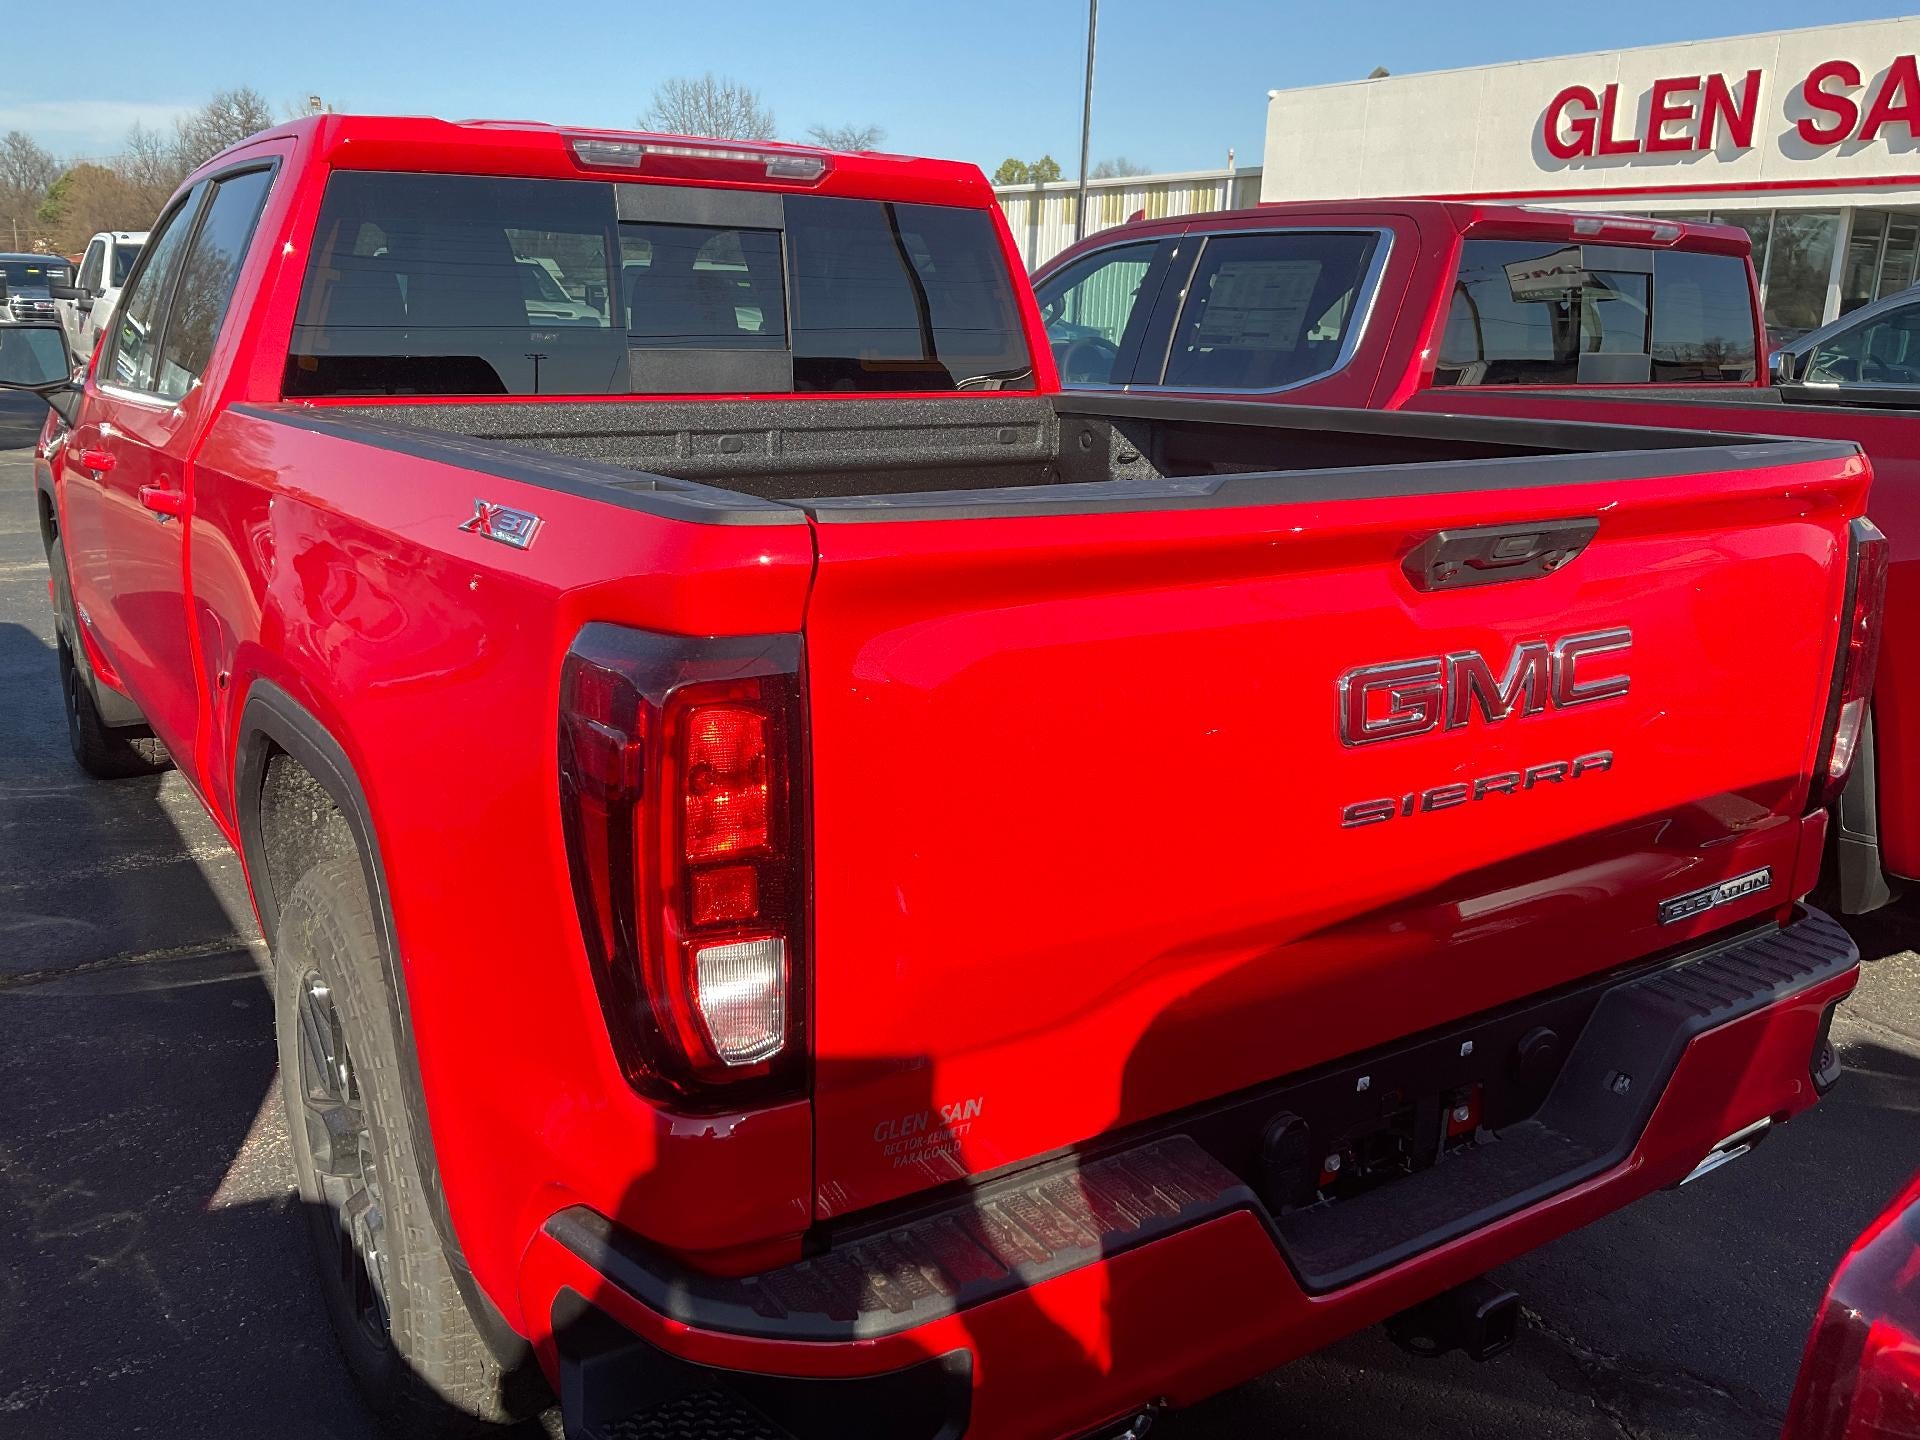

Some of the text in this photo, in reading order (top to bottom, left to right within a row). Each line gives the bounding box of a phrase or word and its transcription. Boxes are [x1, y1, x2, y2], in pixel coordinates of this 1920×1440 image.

[1544, 54, 1920, 160] GLEN SA
[457, 497, 532, 537] X31
[1338, 626, 1633, 750] GMC
[1340, 749, 1615, 830] SIERRA
[1663, 873, 1770, 918] ELEVATION
[873, 1096, 984, 1143] GLEN SAIN
[883, 1122, 972, 1158] RECTOR-KENNETT
[893, 1139, 962, 1169] PARAGOULD
